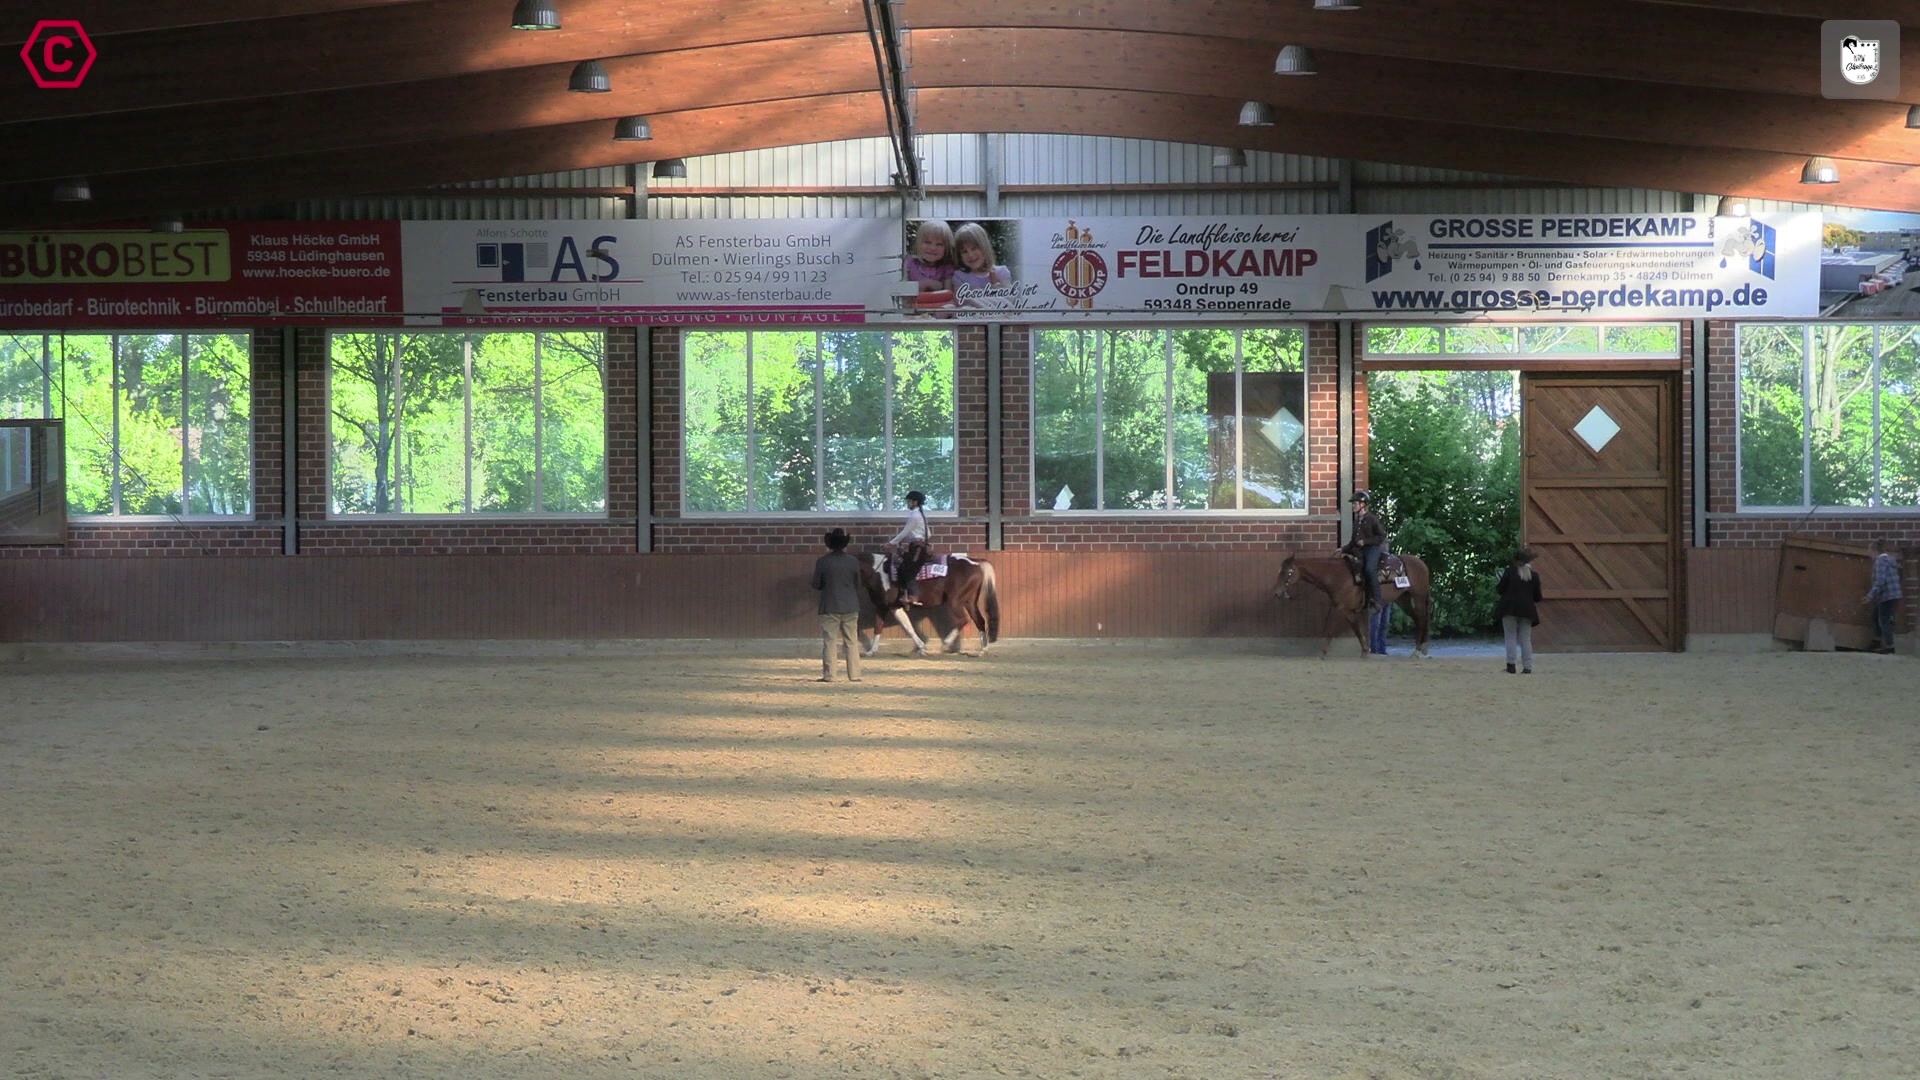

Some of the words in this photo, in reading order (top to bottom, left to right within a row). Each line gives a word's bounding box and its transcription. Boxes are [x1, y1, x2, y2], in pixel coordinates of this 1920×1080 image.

[1429, 218, 1534, 238] GROSSE
[1541, 216, 1697, 238] PERDEKAMP
[250, 233, 289, 247] Klaus
[292, 232, 335, 247] Höcke
[338, 233, 380, 246] GmbH
[676, 235, 694, 248] AS
[699, 234, 781, 249] Fensterbau
[786, 234, 831, 248] GmbH
[1136, 225, 1164, 246] Die
[1168, 223, 1300, 251] Landfleischerei
[0, 235, 218, 278] BÜROBEST
[247, 250, 286, 263] 59348
[290, 248, 385, 264] Lüdinghausen
[550, 235, 620, 282] AS
[652, 252, 710, 266] Dülmen
[723, 252, 791, 270] Wierlings
[797, 252, 840, 265] Busch
[846, 252, 855, 265] 3
[1117, 249, 1318, 278] FELDKAMP
[1428, 251, 1467, 262] Heizung
[1475, 250, 1509, 260] Sanitär
[1517, 250, 1575, 260] Brunnenbau
[1583, 250, 1608, 260] Solar
[1616, 249, 1715, 261] Erdwärmebohrungen
[242, 265, 391, 280] www.hoecke-buero.de
[1448, 260, 1519, 273] Wärmepumpen
[1545, 260, 1563, 270] und
[1565, 260, 1695, 272] Gasfeuerungskundendienst
[1428, 272, 1446, 283] Tel.
[1547, 272, 1611, 284] Dernekamp
[1613, 271, 1627, 281] 35
[1671, 270, 1715, 281] Dülmen
[477, 288, 568, 302] Fensterbau
[573, 288, 620, 302] GmbH
[677, 287, 832, 302] www.as-fensterbau.de
[957, 282, 1019, 304] Geschmack
[1022, 283, 1039, 296] ist
[1176, 282, 1236, 299] Ondrup
[1240, 282, 1259, 295] 49
[1372, 283, 1769, 313] www.grosse-perdekamp.de
[87, 297, 182, 316] Bürotechnik
[194, 296, 281, 315] Büromöbel
[293, 295, 387, 314] Schulbedarf
[1144, 299, 1192, 310] 59348
